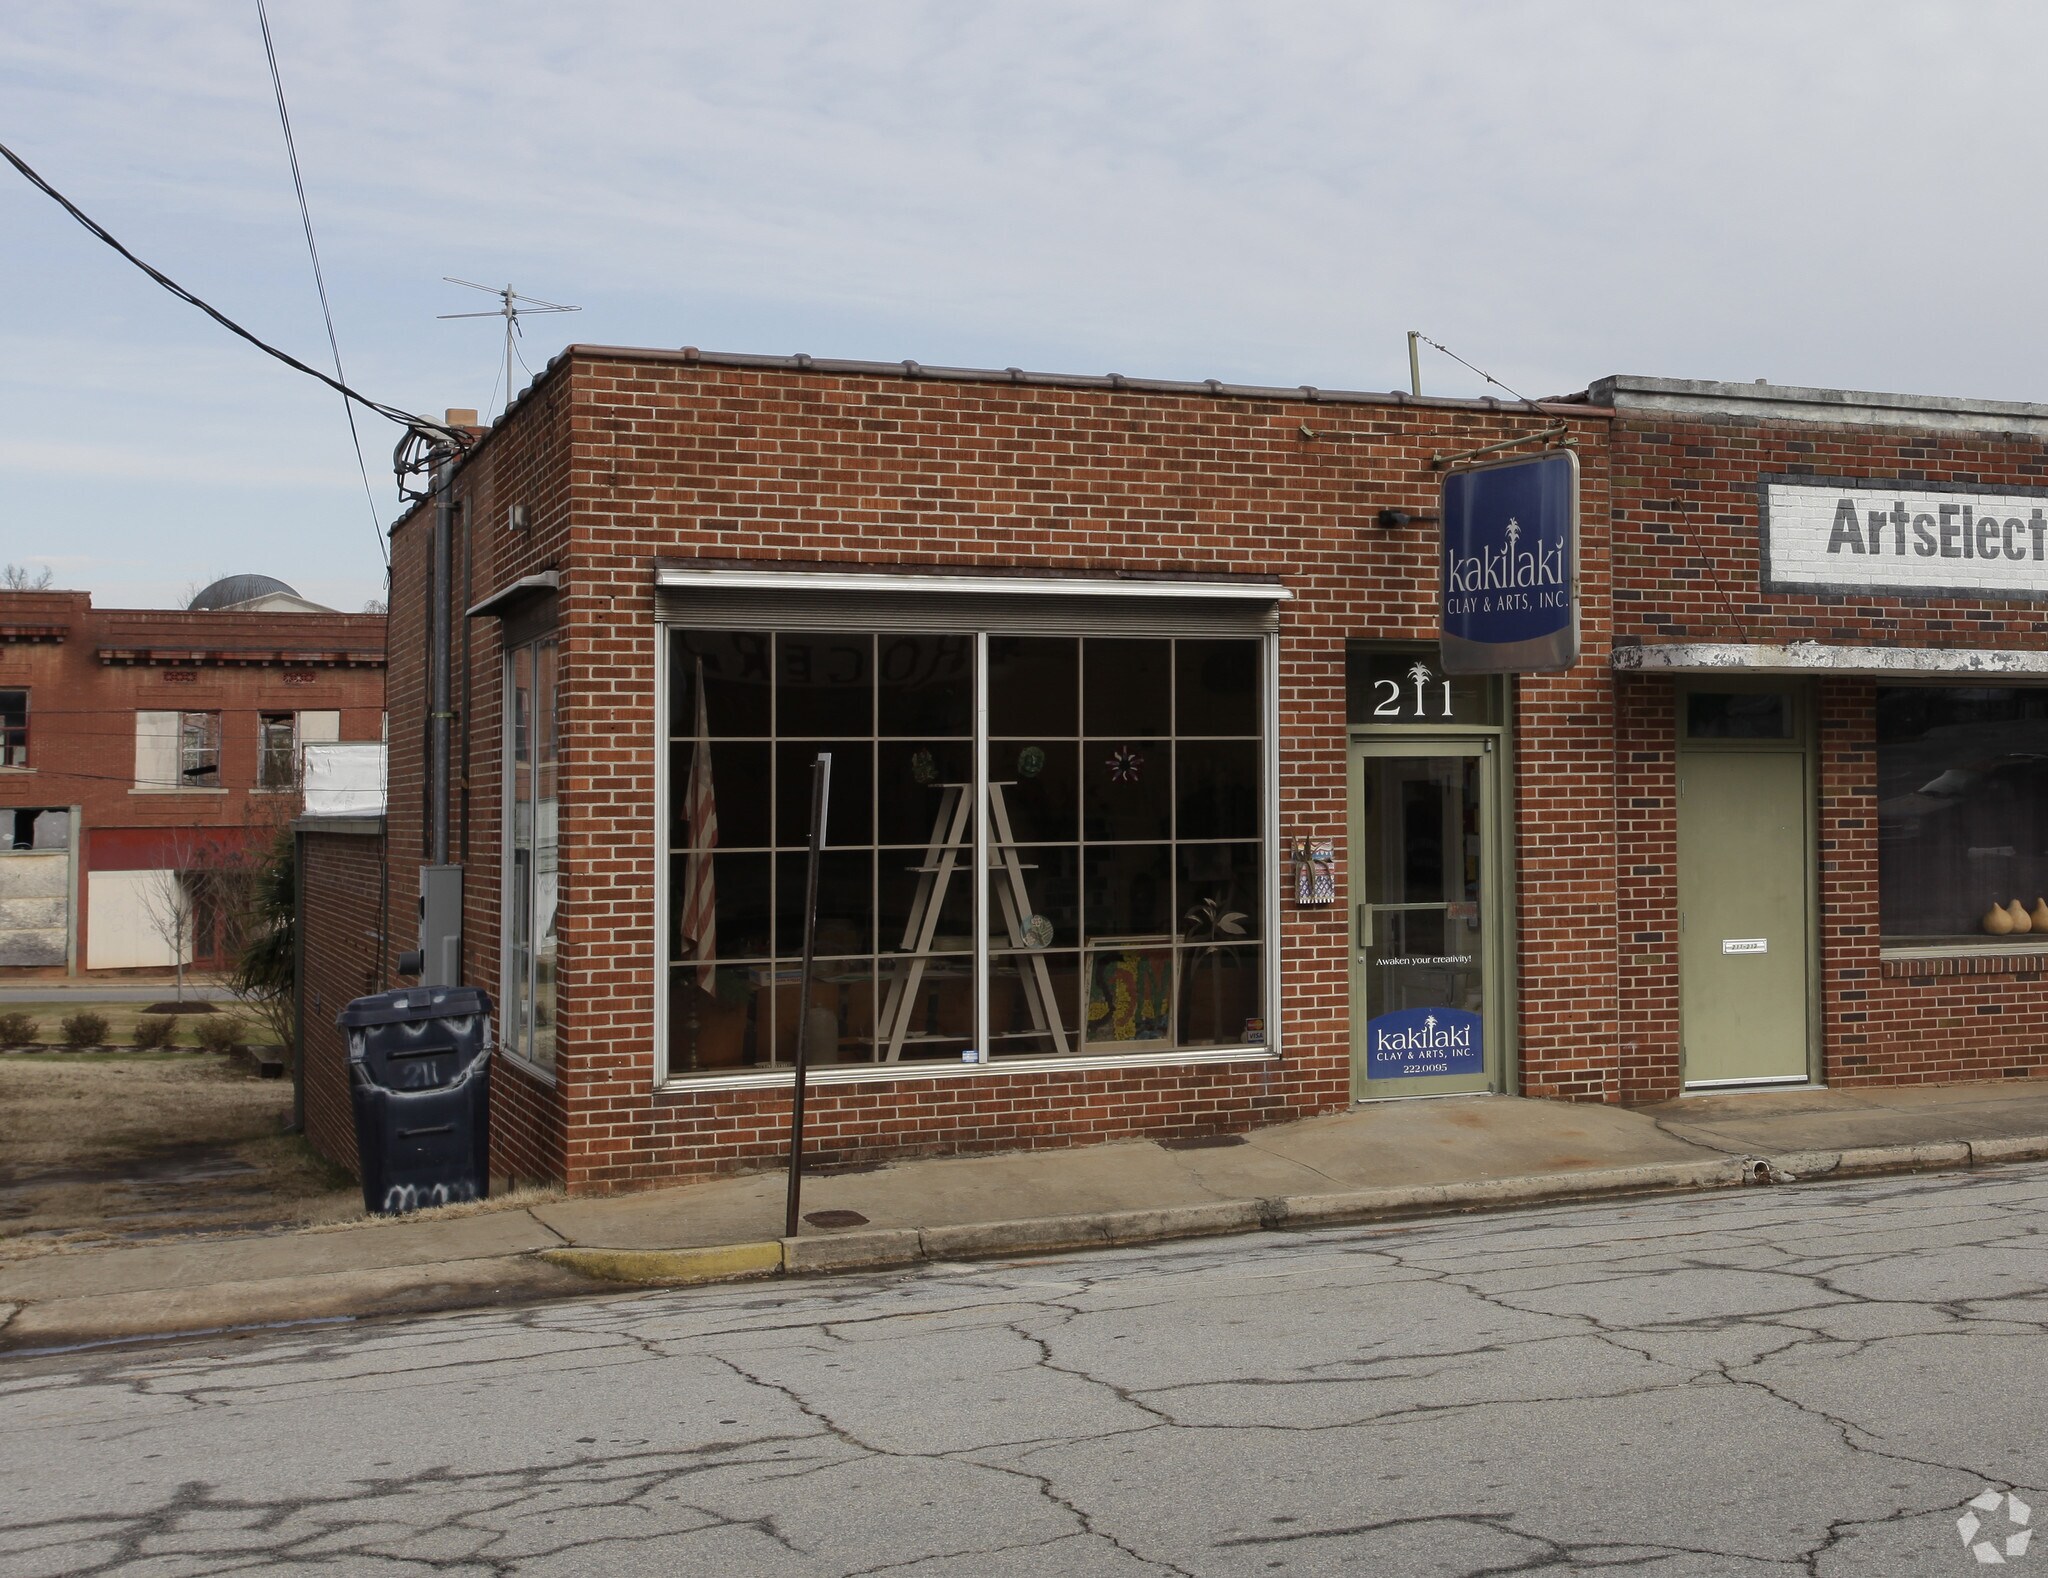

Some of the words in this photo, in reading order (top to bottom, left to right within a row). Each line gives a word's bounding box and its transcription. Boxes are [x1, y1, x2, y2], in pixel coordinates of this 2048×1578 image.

[1826, 498, 2048, 561] ArtsElect
[1448, 517, 1564, 593] kakilaki
[1447, 597, 1478, 615] CLAY
[1483, 599, 1492, 612] &
[1496, 594, 1533, 613] ARTS,
[1539, 590, 1570, 609] INC.
[1373, 662, 1453, 716] 211
[1376, 957, 1410, 965] Awaken
[1412, 957, 1431, 965] your
[1433, 955, 1472, 963] creativity!
[1377, 1015, 1470, 1051] kakilaki
[1376, 1052, 1403, 1061] CLAY
[1407, 1051, 1414, 1060] &
[1418, 1049, 1447, 1059] ARTS,
[1452, 1047, 1475, 1057] INC.
[1404, 1064, 1447, 1073] 222.0095
